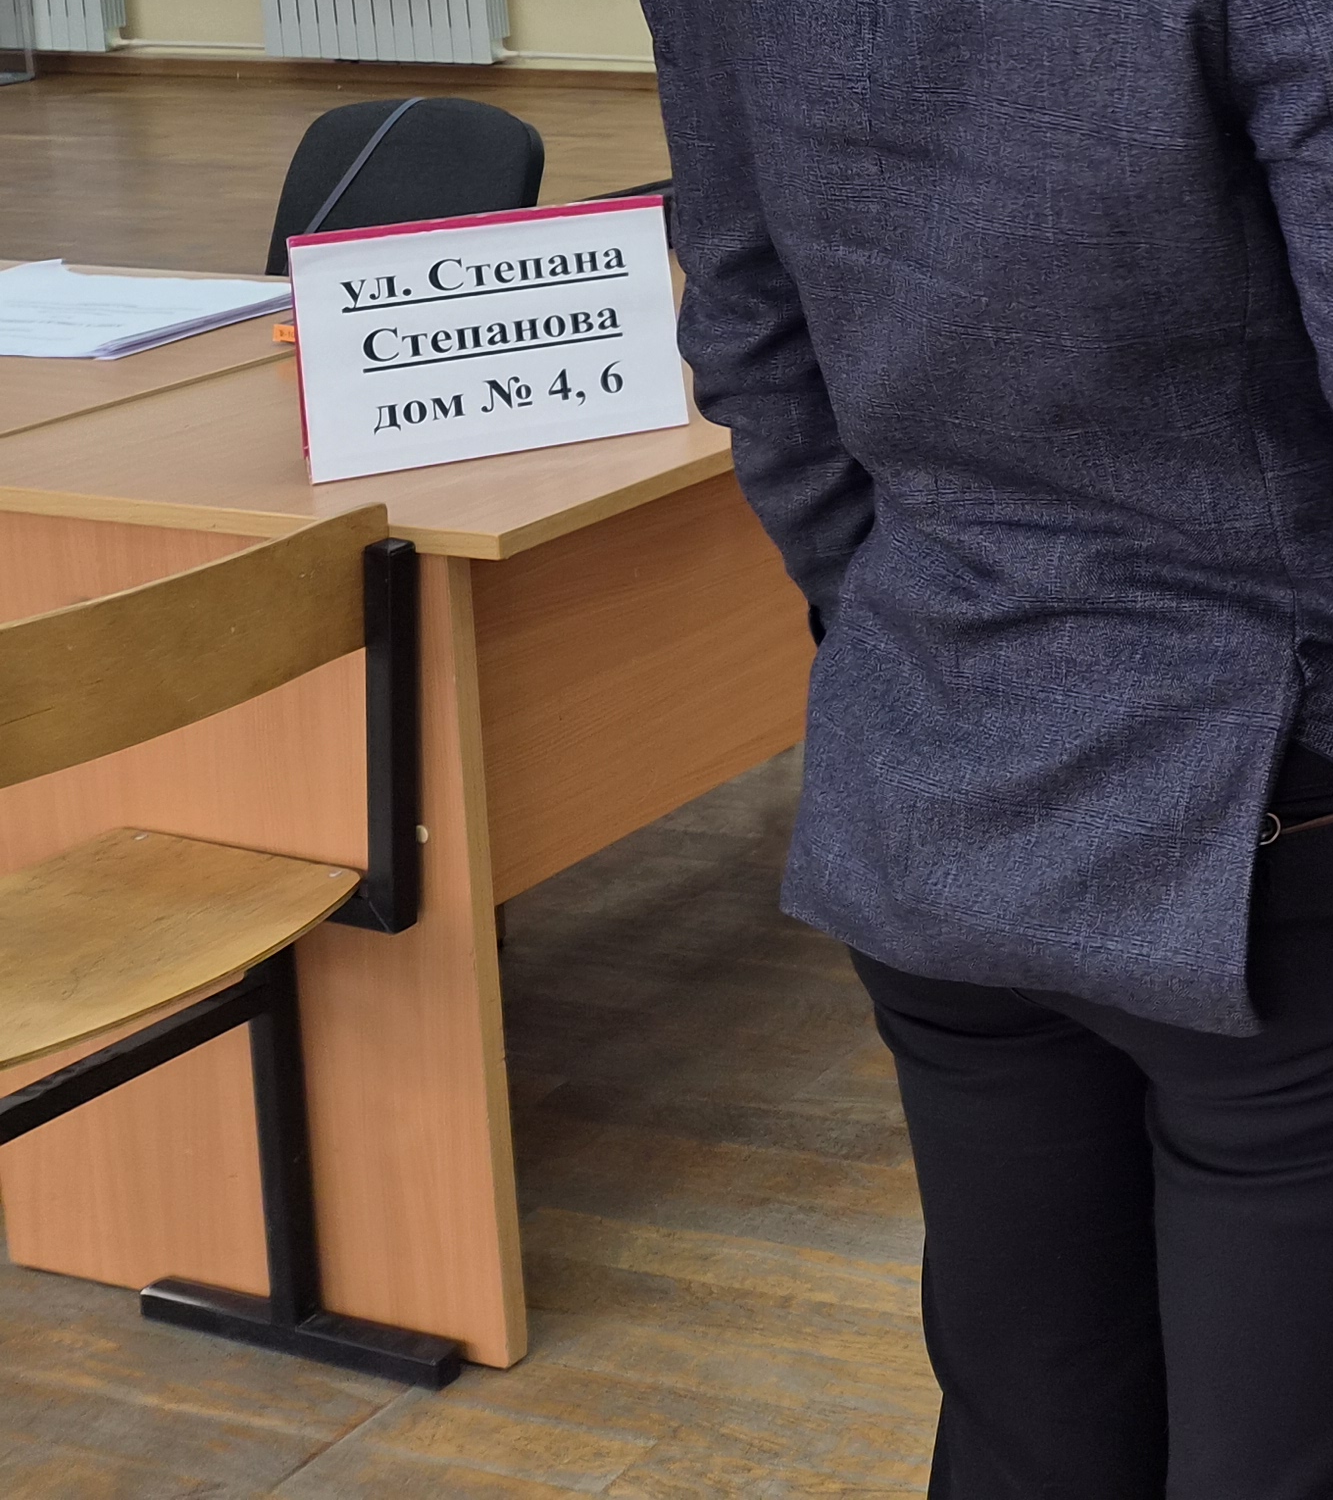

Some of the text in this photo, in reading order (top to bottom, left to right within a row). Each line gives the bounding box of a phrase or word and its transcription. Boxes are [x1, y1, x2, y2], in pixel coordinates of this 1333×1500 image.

[340, 246, 626, 309] ул. Степана
[362, 307, 620, 363] Степанова
[374, 361, 624, 434] дом № 4, 6
